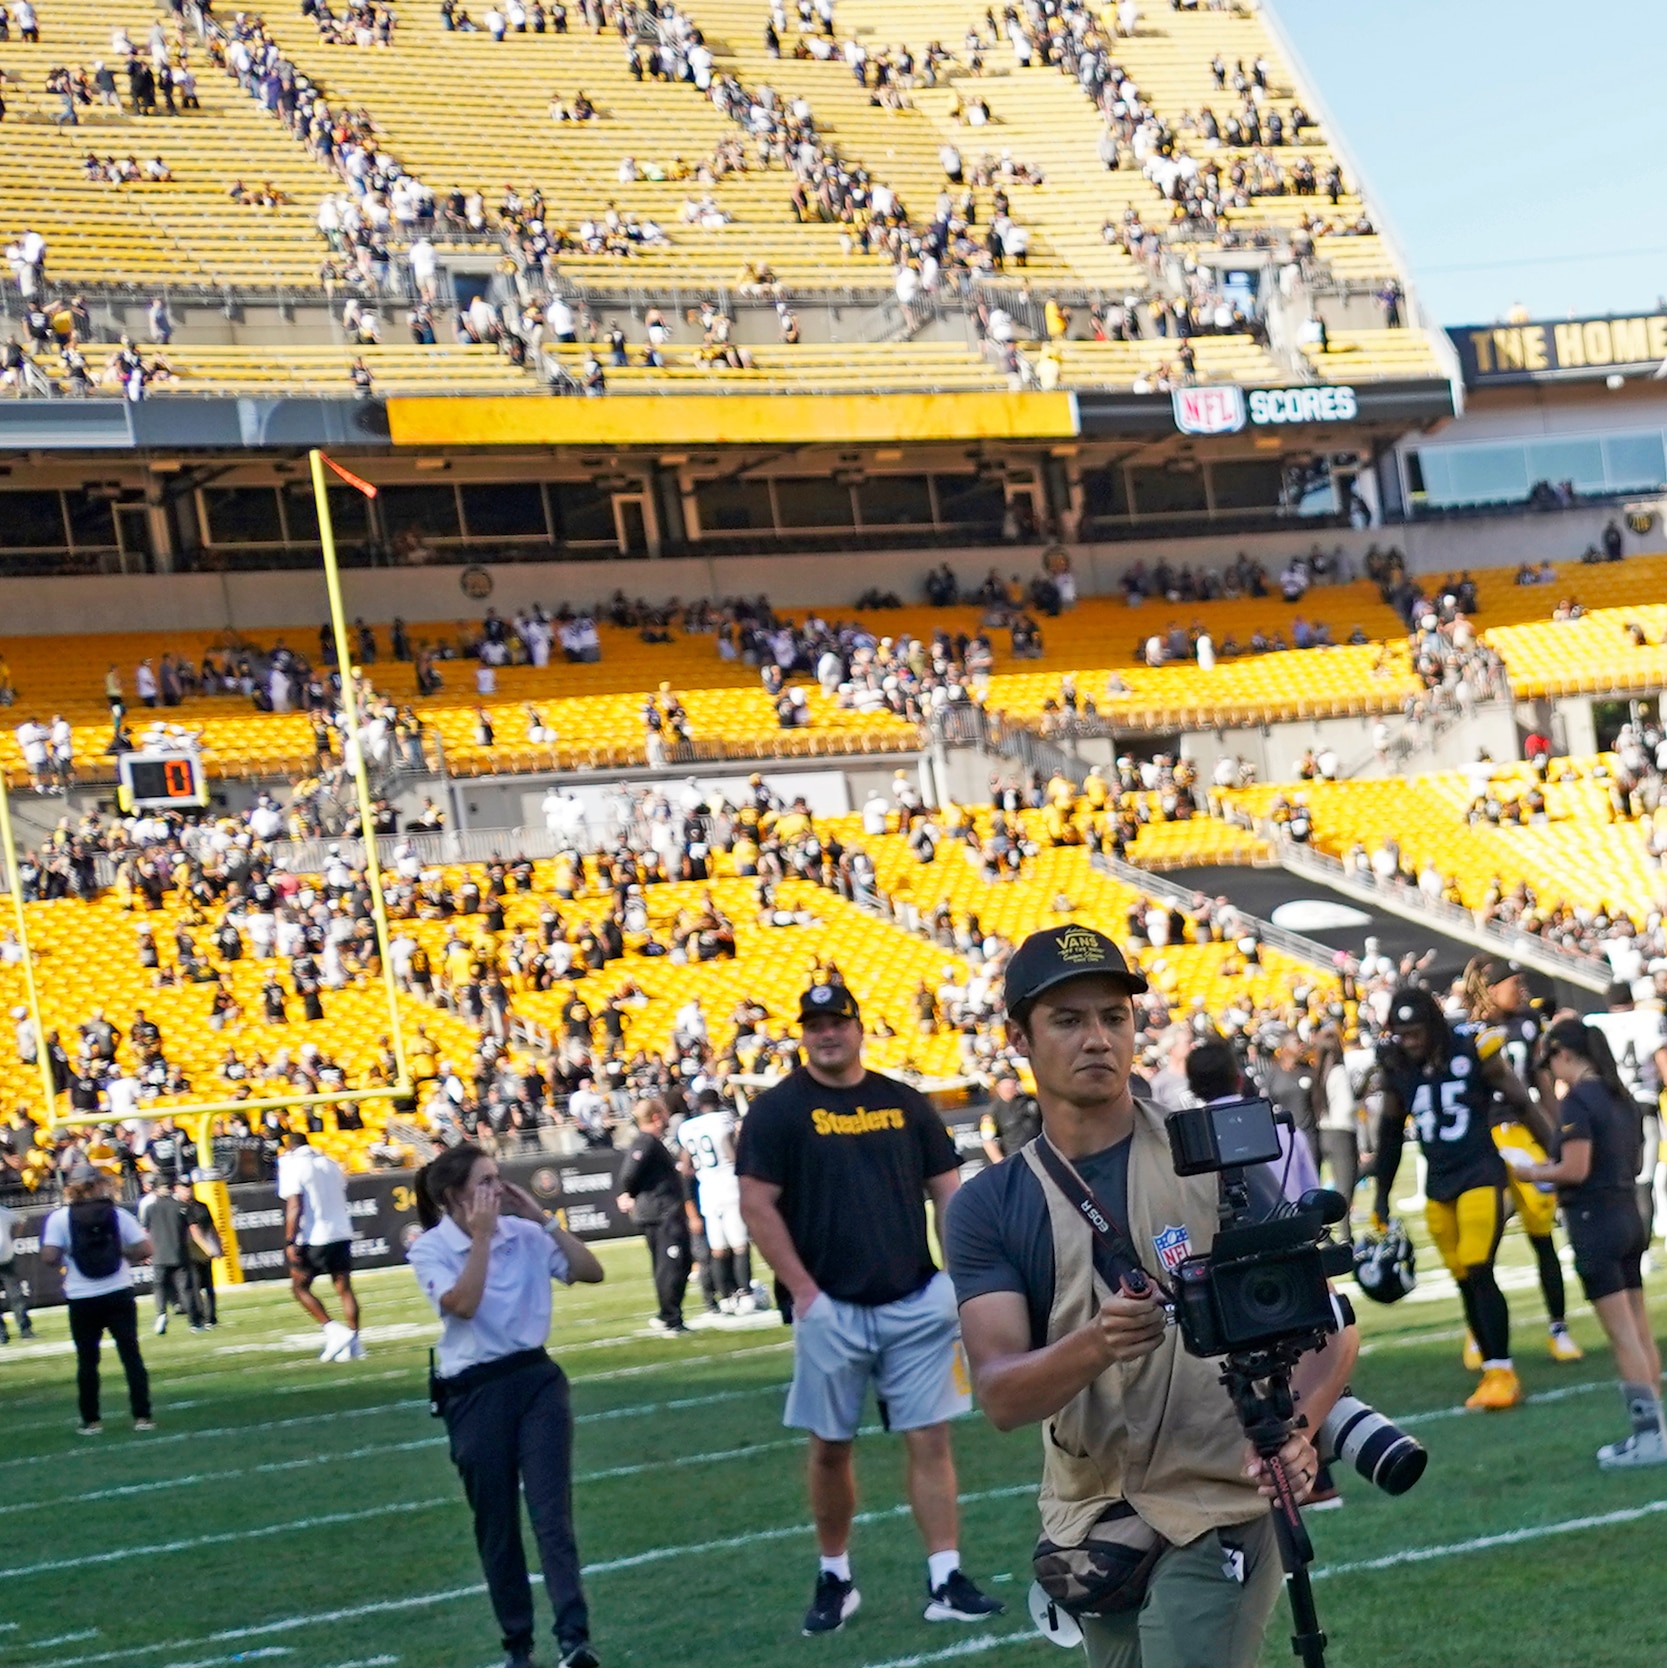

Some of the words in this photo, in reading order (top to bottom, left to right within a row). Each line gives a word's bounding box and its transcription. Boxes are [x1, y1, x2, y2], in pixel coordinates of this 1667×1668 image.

[1471, 326, 1549, 373] THE
[1249, 386, 1357, 424] SCORES
[164, 760, 192, 797] 0
[1055, 933, 1099, 950] VANS
[811, 1106, 905, 1135] Steelers
[1411, 1080, 1470, 1143] 45
[1080, 1200, 1091, 1211] R
[1087, 1206, 1109, 1233] EOS
[1162, 1242, 1191, 1267] NFL
